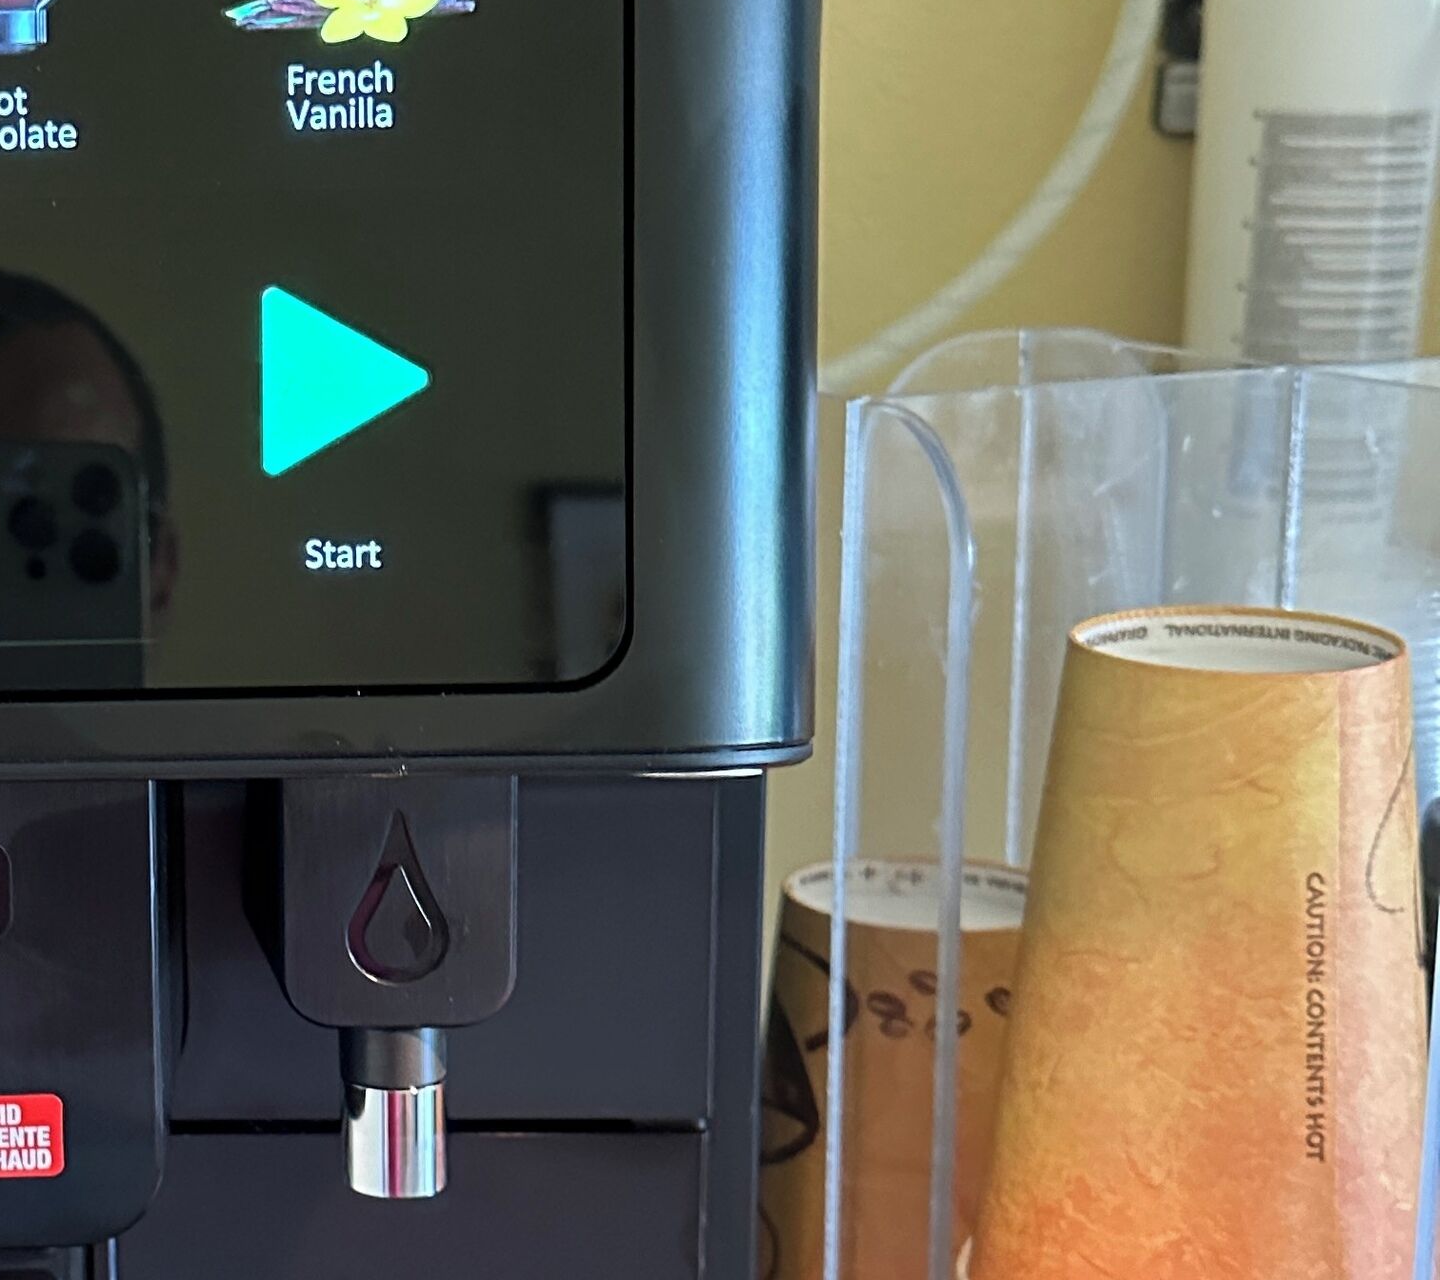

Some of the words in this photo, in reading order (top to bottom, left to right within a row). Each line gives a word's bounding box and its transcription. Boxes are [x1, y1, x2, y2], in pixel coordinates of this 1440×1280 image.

[287, 60, 394, 96] French
[286, 96, 394, 131] Vanilla
[305, 538, 382, 570] Start
[1305, 871, 1325, 983] CAUTION:
[1305, 988, 1325, 1108] CONTENTS
[1305, 1113, 1325, 1163] HOT
